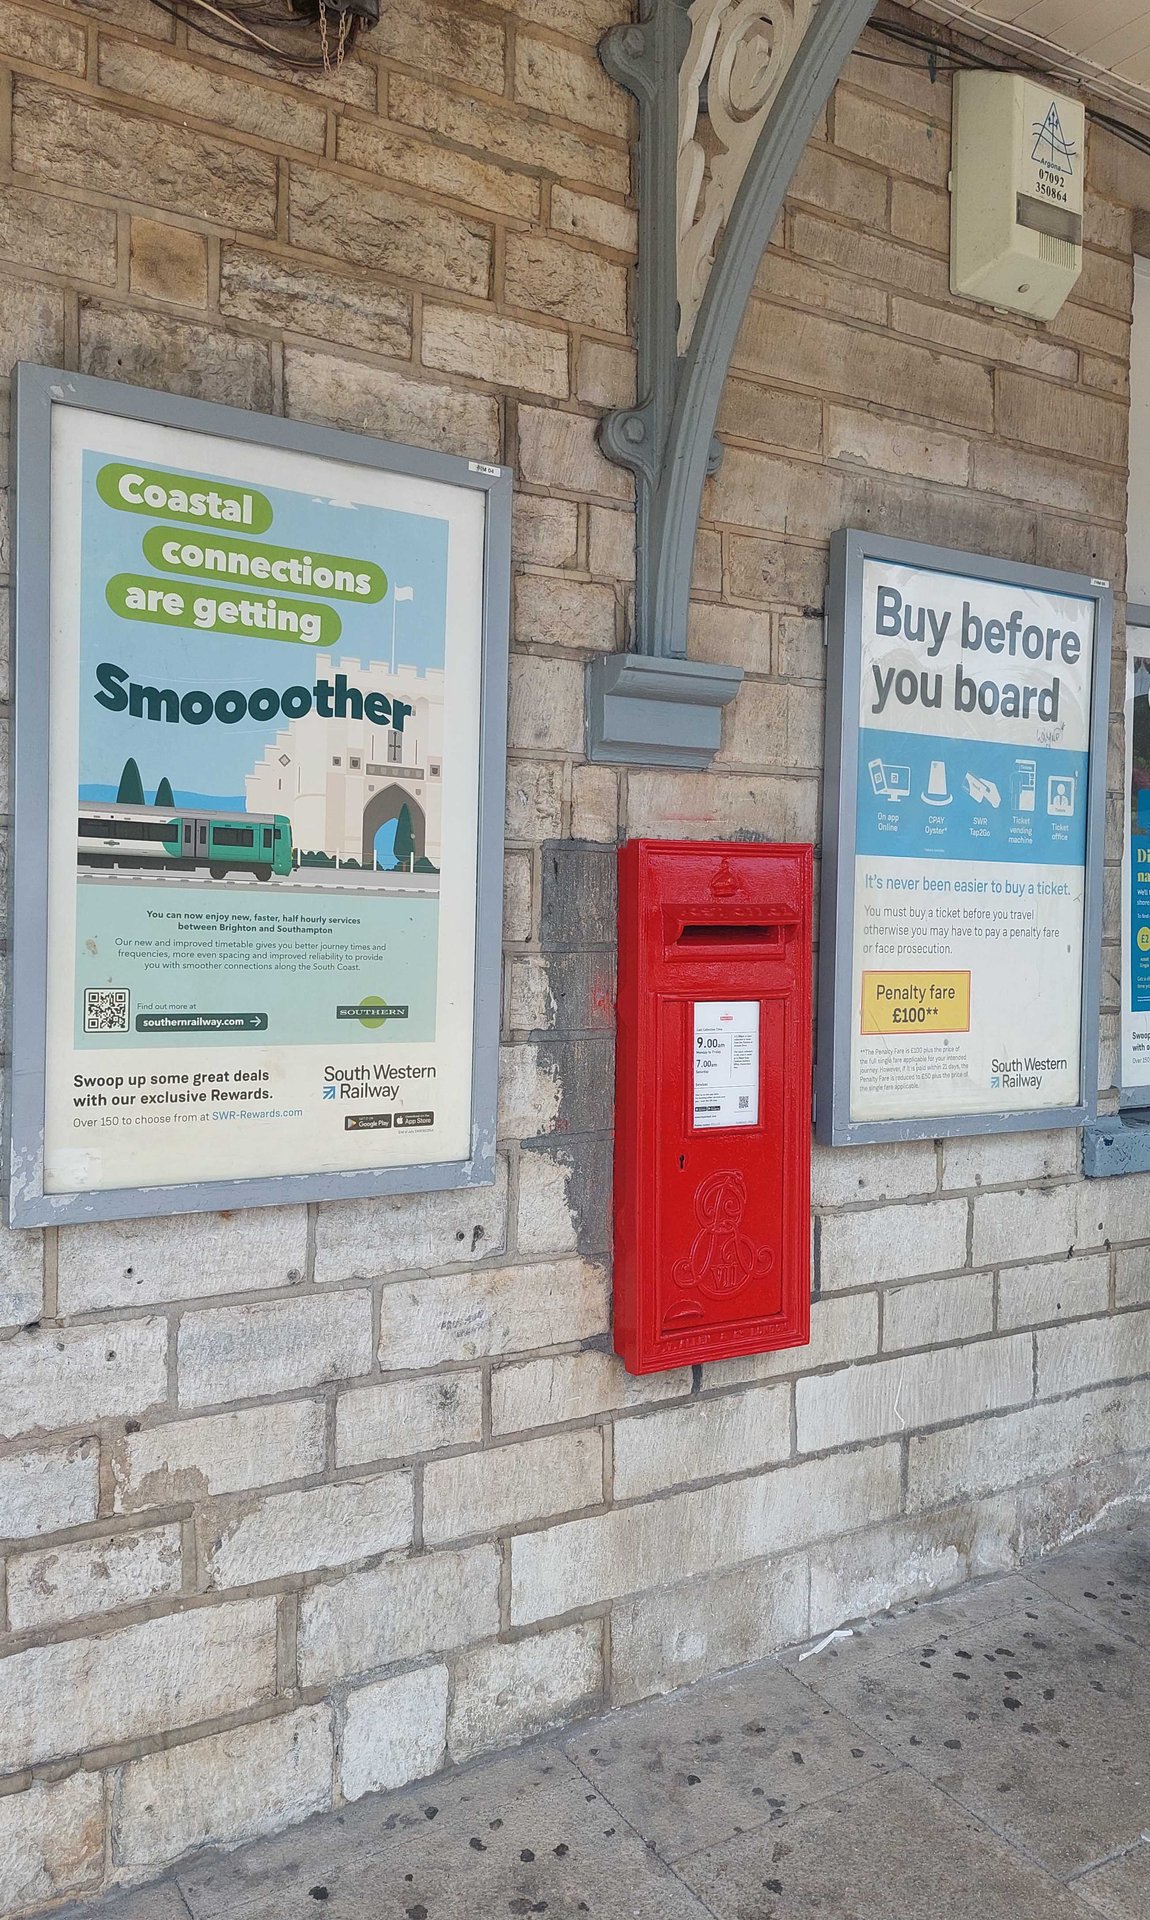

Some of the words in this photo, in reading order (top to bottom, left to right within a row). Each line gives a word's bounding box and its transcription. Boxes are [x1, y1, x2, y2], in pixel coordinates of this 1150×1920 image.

[1040, 158, 1061, 171] Argona
[1039, 169, 1065, 188] 07092
[1036, 182, 1067, 203] 350864
[118, 473, 253, 525] Coastal
[162, 540, 372, 595] connections
[125, 585, 185, 615] are
[193, 594, 322, 643] getting
[876, 586, 952, 657] Buy
[961, 602, 1081, 664] before
[94, 663, 413, 733] Smoooother
[871, 665, 943, 715] you
[955, 664, 1060, 723] board
[878, 812, 886, 820] On
[887, 814, 899, 822] app
[929, 816, 945, 825] CPAY
[973, 817, 988, 825] SWR
[1012, 816, 1030, 825] Ticket
[878, 822, 898, 832] Online
[969, 828, 991, 837] Tap2Go
[1010, 827, 1033, 836] vending
[1051, 823, 1070, 832] Ticket
[1008, 836, 1033, 844] machine
[1052, 833, 1068, 841] office
[887, 878, 919, 890] never
[923, 877, 951, 892] been
[954, 879, 988, 893] easier
[991, 881, 1002, 893] to
[1005, 880, 1025, 897] buy
[1028, 884, 1034, 894] a
[1037, 882, 1071, 896] ticket.
[147, 910, 163, 919] You
[206, 912, 229, 922] enjoy
[232, 914, 252, 922] new,
[254, 914, 280, 922] faster,
[283, 914, 299, 922] half
[301, 915, 326, 925] hourly
[864, 905, 881, 917] You
[884, 907, 907, 918] must
[909, 907, 926, 921] buy
[928, 910, 934, 918] a
[936, 907, 961, 918] ticket
[963, 908, 991, 919] before
[993, 911, 1008, 921] you
[1010, 909, 1034, 920] travel
[178, 922, 217, 931] between
[220, 924, 257, 933] Brighton
[277, 925, 333, 935] Southampton
[864, 925, 909, 936] otherwise
[912, 927, 928, 938] you
[930, 928, 949, 939] may
[951, 926, 972, 937] have
[975, 927, 983, 937] to
[985, 928, 1000, 939] pay
[1010, 927, 1041, 939] penalty
[1043, 927, 1060, 938] fare
[115, 938, 132, 946] Our
[155, 938, 171, 946] and
[174, 939, 213, 949] improved
[216, 940, 253, 948] timetable
[256, 942, 277, 950] gives
[278, 943, 293, 951] you
[320, 942, 348, 952] journey
[350, 943, 371, 951] times
[863, 945, 873, 954] or
[875, 943, 895, 954] face
[897, 943, 953, 956] prosecution.
[118, 949, 170, 959] frequencies,
[219, 952, 250, 961] spacing
[270, 952, 307, 961] improved
[309, 953, 344, 962] reliability
[355, 954, 384, 962] provide
[144, 962, 160, 970] you
[163, 961, 180, 969] with
[182, 962, 222, 970] smoother
[224, 962, 272, 970] connections
[275, 962, 296, 972] along
[337, 963, 361, 971] Coast.
[877, 984, 926, 1003] Penalty
[930, 984, 956, 1000] fare
[143, 1017, 244, 1028] southernrailway.com
[324, 1065, 370, 1082] South
[373, 1064, 436, 1080] Western
[992, 1058, 1023, 1073] South
[1024, 1058, 1067, 1071] Western
[73, 1074, 124, 1089] Swoop
[128, 1075, 146, 1088] up
[150, 1072, 189, 1085] some
[193, 1071, 230, 1086] great
[234, 1070, 269, 1082] deals
[1003, 1074, 1042, 1090] Railway
[73, 1093, 107, 1108] with
[111, 1094, 136, 1106] our
[141, 1090, 207, 1105] exclusive
[211, 1088, 273, 1101] Rewards.
[340, 1083, 400, 1101] Railway
[73, 1118, 98, 1128] Over
[101, 1117, 119, 1127] 150
[122, 1116, 132, 1126] to
[135, 1114, 171, 1125] choose
[173, 1113, 198, 1123] from
[200, 1112, 210, 1121] at
[212, 1108, 303, 1121] SWR-Rewards.com
